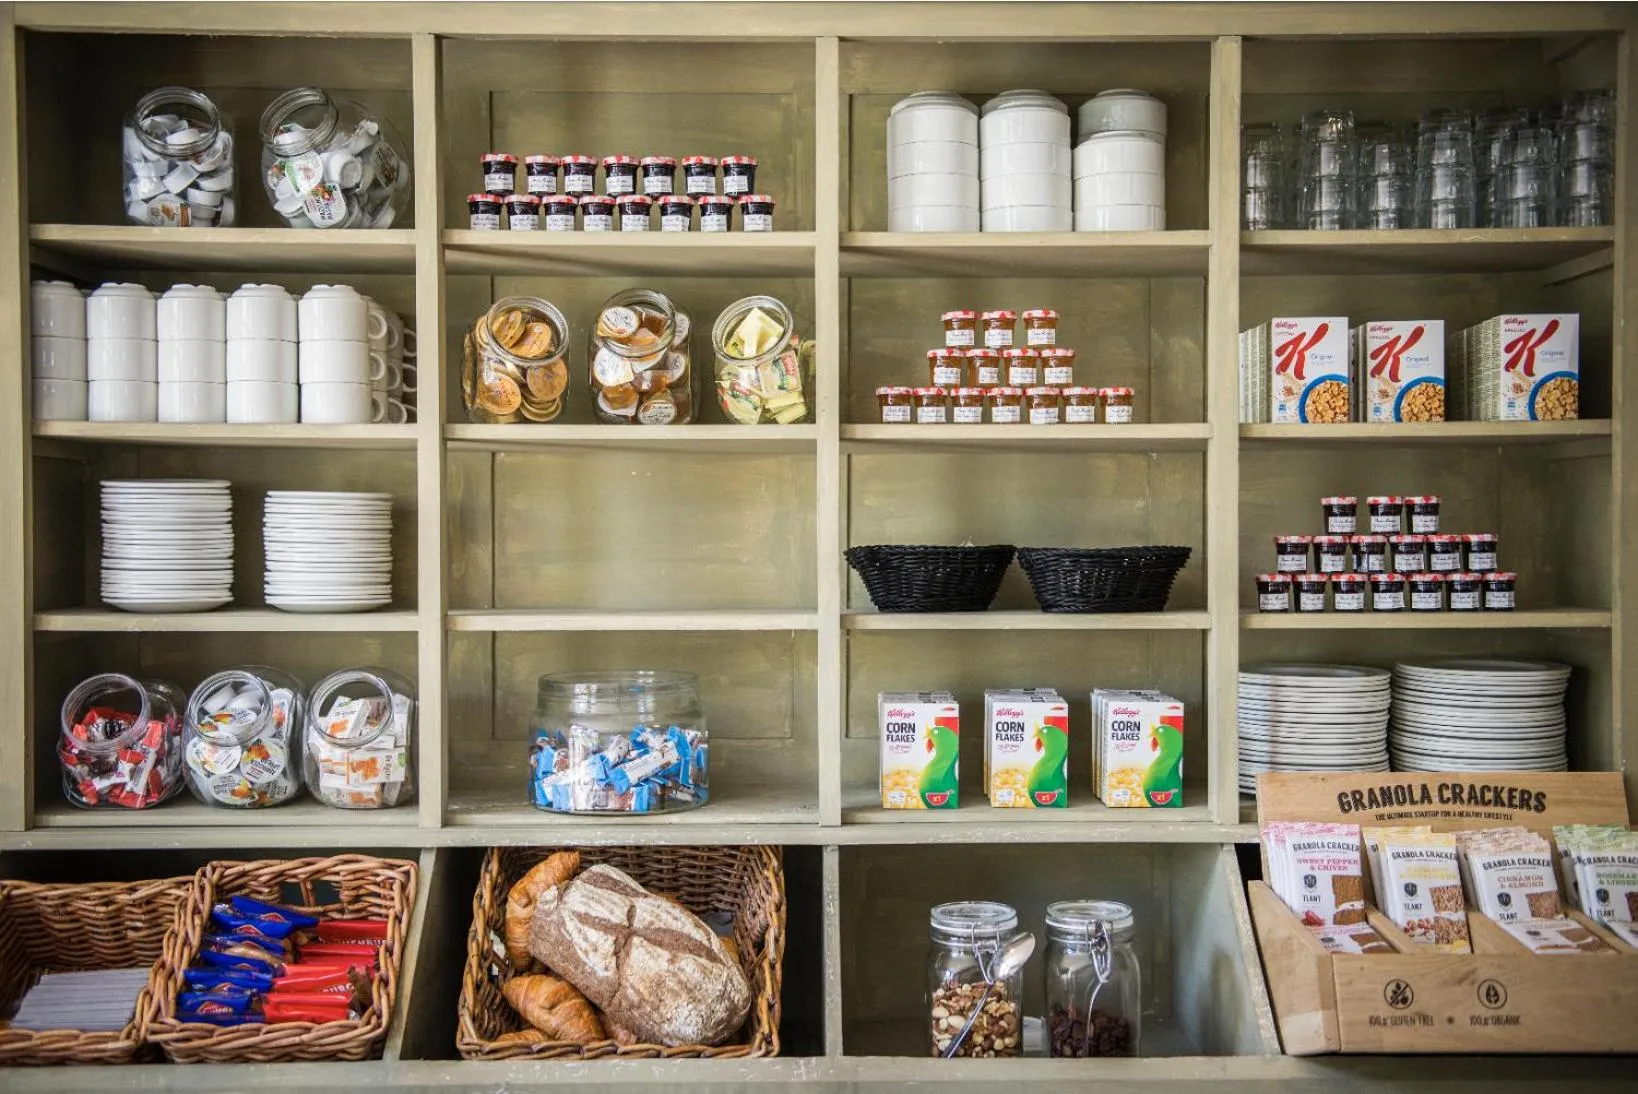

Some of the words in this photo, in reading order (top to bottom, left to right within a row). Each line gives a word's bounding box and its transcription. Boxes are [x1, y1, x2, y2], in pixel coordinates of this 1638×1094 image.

[1274, 322, 1329, 380] K
[1504, 318, 1560, 377] K
[1369, 325, 1425, 383] K
[886, 722, 916, 734] CORN
[995, 721, 1025, 733] CORN
[1111, 720, 1141, 732] CORN
[886, 734, 916, 743] FLAKES
[995, 733, 1025, 742] FLAKES
[1111, 732, 1140, 741] FLAKES
[1337, 783, 1434, 815] GRANOLA
[1437, 782, 1547, 814] CRACKERS
